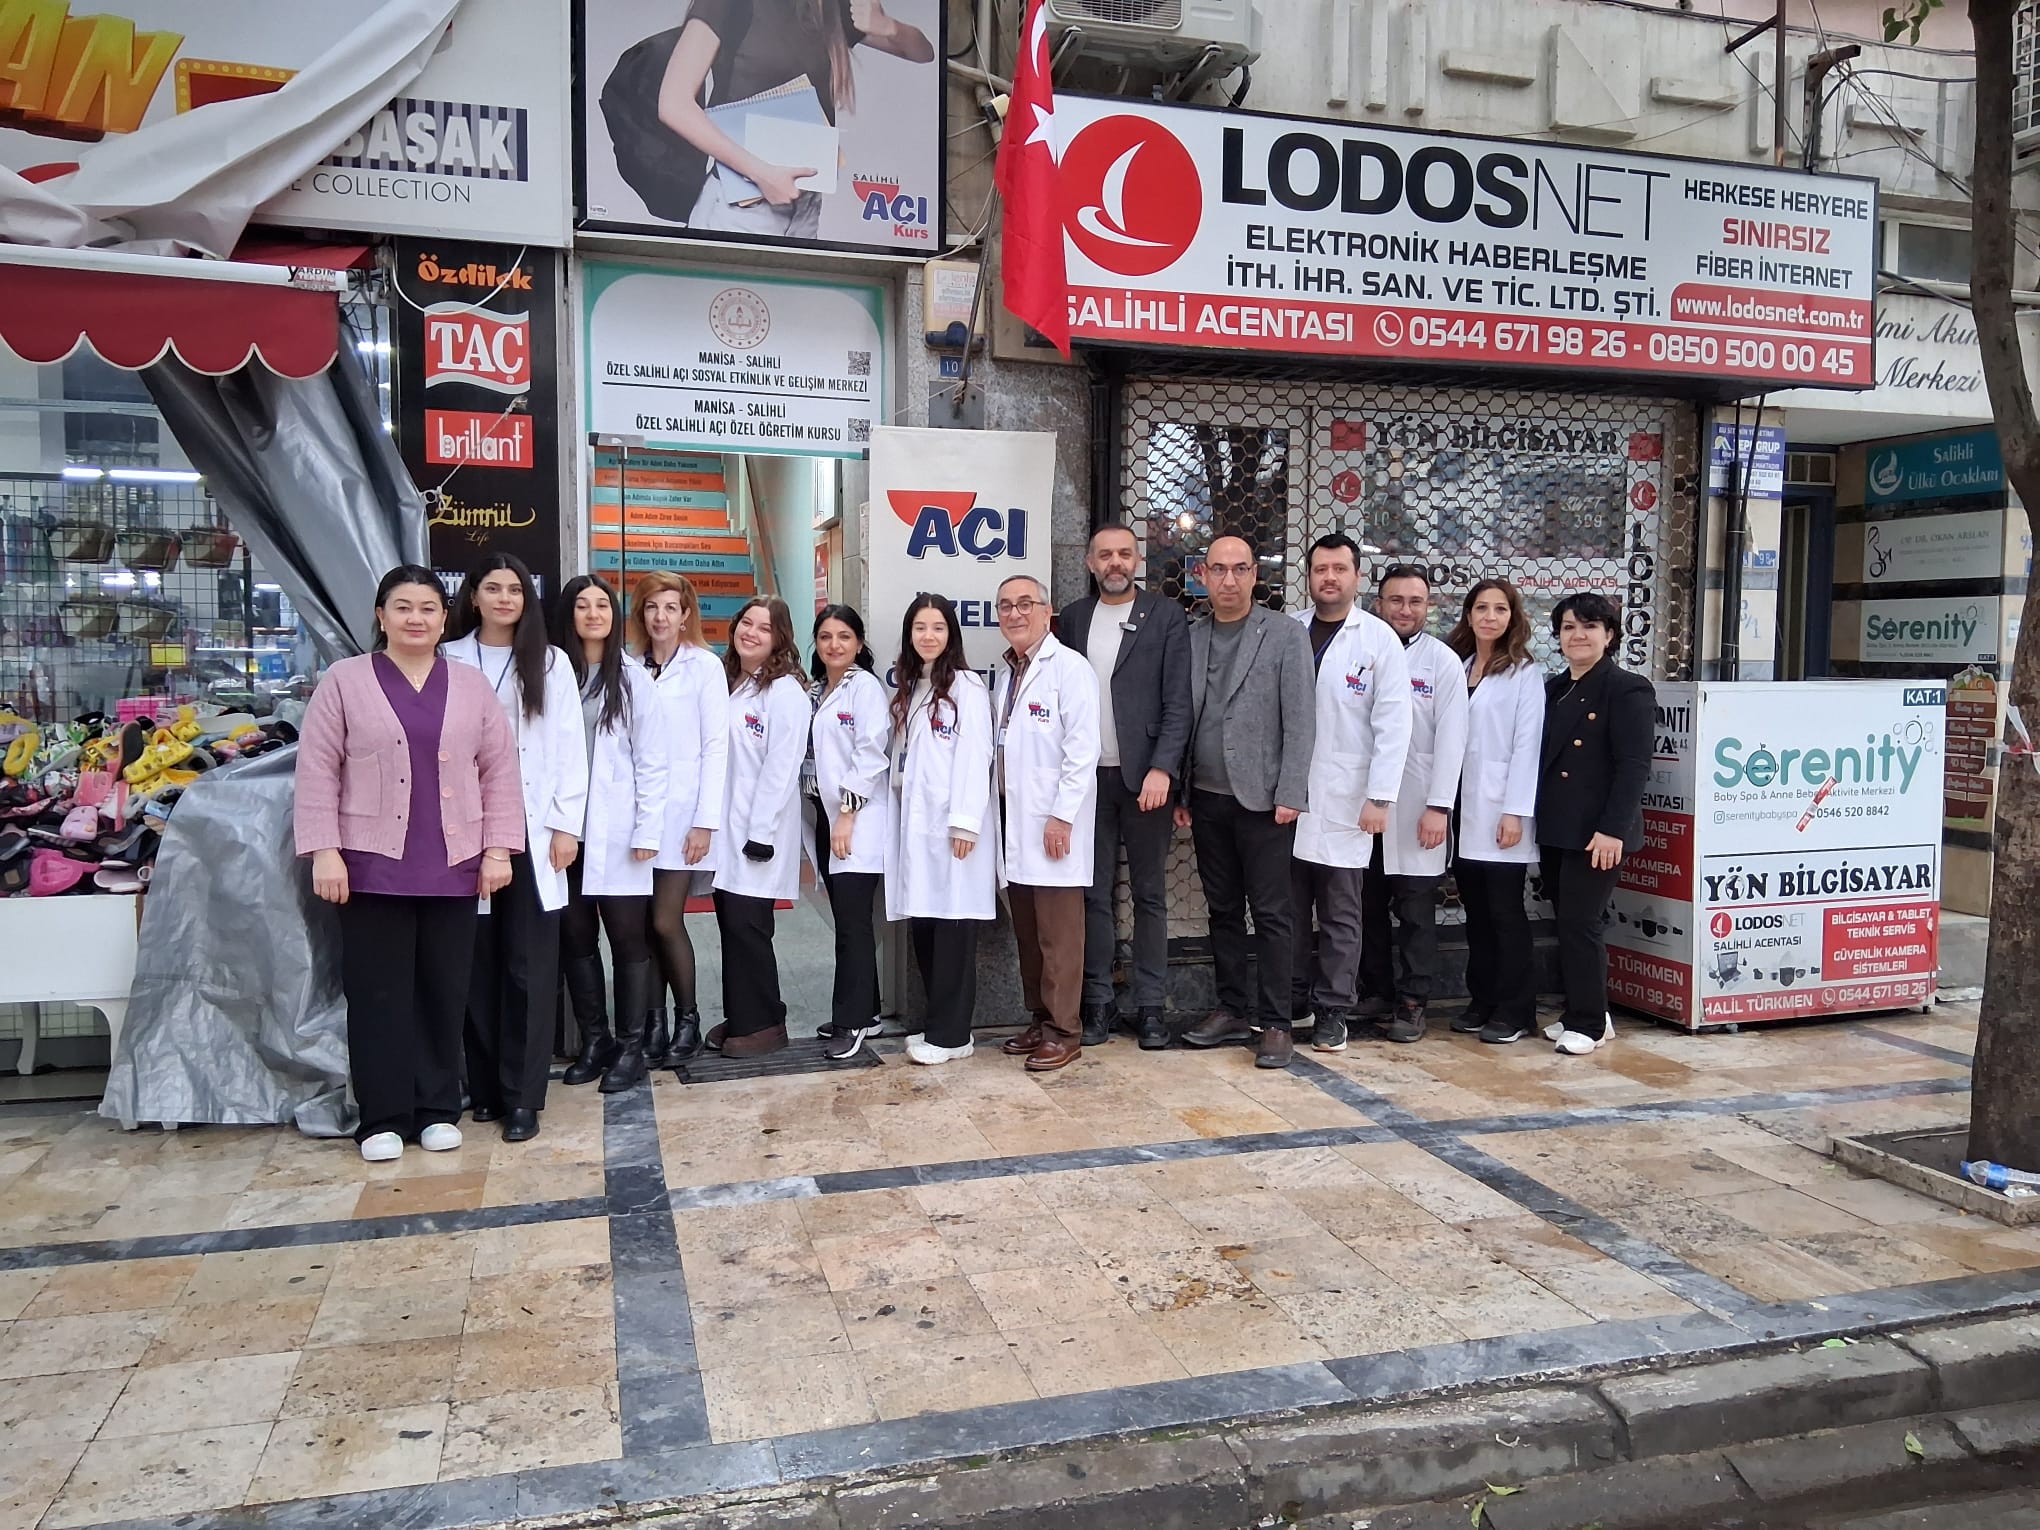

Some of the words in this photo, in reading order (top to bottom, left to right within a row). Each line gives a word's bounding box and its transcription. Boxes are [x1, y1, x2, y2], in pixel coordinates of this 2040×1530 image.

[313, 172, 471, 203] COLLECTION
[853, 173, 899, 185] SALİHLİ
[863, 191, 927, 225] AÇI
[1684, 178, 1775, 209] HERKESE
[1781, 190, 1868, 220] HERYERE
[894, 224, 928, 239] Kurs
[1723, 217, 1831, 254] SINIRSIZ
[1246, 224, 1440, 263] ELEKTRONİK
[1448, 241, 1647, 283] HABERLEŞME
[417, 252, 533, 290] Özdilek
[1696, 250, 1753, 279] FİBER
[1759, 255, 1853, 290] İNTERNET
[1227, 254, 1284, 289] İTH.
[1294, 259, 1352, 294] İHR.
[1362, 271, 1433, 300] SAN.
[1442, 277, 1483, 303] VE
[1491, 276, 1541, 307] TİC.
[1550, 285, 1605, 313] LTD.
[1613, 287, 1661, 321] ŞTİ.
[1195, 304, 1354, 342] ACENTASI
[1676, 294, 1864, 330] www.lodosnet.com.tr
[430, 321, 523, 384] TAÇ
[699, 351, 736, 366] MANİSA
[746, 354, 781, 369] SALİHLİ
[1409, 316, 1487, 349] 0544
[1494, 322, 1540, 353] 671
[1547, 325, 1583, 355] 98
[1590, 329, 1626, 358] 26
[1650, 333, 1718, 365] 0850
[1725, 339, 1775, 369] 500
[1782, 343, 1816, 373] 00
[1821, 347, 1854, 375] 45
[606, 361, 631, 376] ÖZEL
[634, 364, 670, 379] SALİHLİ
[673, 367, 689, 382] AÇI
[692, 369, 727, 383] SOSYAL
[730, 371, 771, 386] ETKİNLİK
[774, 375, 785, 386] VE
[788, 375, 825, 391] GELİŞİM
[828, 379, 867, 393] MERKEZİ
[1875, 356, 1982, 393] Merkezi
[694, 399, 736, 415] MANİSA
[747, 401, 786, 418] SALİHLİ
[438, 417, 523, 461] brillant
[636, 413, 663, 430] ÖZEL
[666, 416, 706, 433] SALİHLİ
[709, 420, 726, 436] AÇI
[730, 419, 756, 435] ÖZEL
[759, 421, 804, 439] ÖĞRETİM
[807, 426, 841, 441] KURSU
[1756, 441, 1780, 454] GRUP
[907, 505, 1029, 563] AÇI
[1866, 612, 1977, 647] Serenity
[1906, 688, 1941, 704] KAT:1
[1713, 733, 1922, 794] Serenity
[1714, 791, 1738, 803] Baby
[1740, 791, 1758, 802] Spa
[1761, 791, 1767, 800] &
[1770, 790, 1794, 799] Anne
[1861, 786, 1895, 797] Merkezi
[1645, 819, 1687, 836] TABLET
[1725, 809, 1798, 822] serenitybabyspa
[1816, 808, 1842, 819] 0546
[1844, 806, 1864, 817] 520
[1865, 805, 1890, 816] 8842
[1632, 856, 1682, 877] KAMERA
[1704, 865, 1769, 901] YÖN
[1778, 861, 1932, 897] BİLGİSAYAR
[1831, 911, 1886, 925] BİLGİSAYAR
[1887, 910, 1895, 921] &
[1896, 908, 1932, 920] TABLET
[1847, 924, 1881, 939] TEKNİK
[1882, 922, 1916, 936] SERVİS
[1713, 937, 1752, 952] SALİHLİ
[1754, 935, 1802, 949] ACENTASI
[1833, 945, 1883, 961] GÜVENLİK
[1885, 944, 1927, 957] KAMERA
[1617, 954, 1684, 986] TÜRKMEN
[1852, 958, 1908, 975] SİSTEMLERİ
[1625, 982, 1645, 1000] 671
[1646, 988, 1664, 1005] 98
[1666, 993, 1684, 1011] 26
[1704, 998, 1744, 1015] HALİL
[1747, 993, 1813, 1011] TÜRKMEN
[1838, 987, 1871, 1001] 0544
[1872, 985, 1891, 999] 671
[1894, 983, 1909, 997] 98
[1911, 982, 1927, 995] 26
